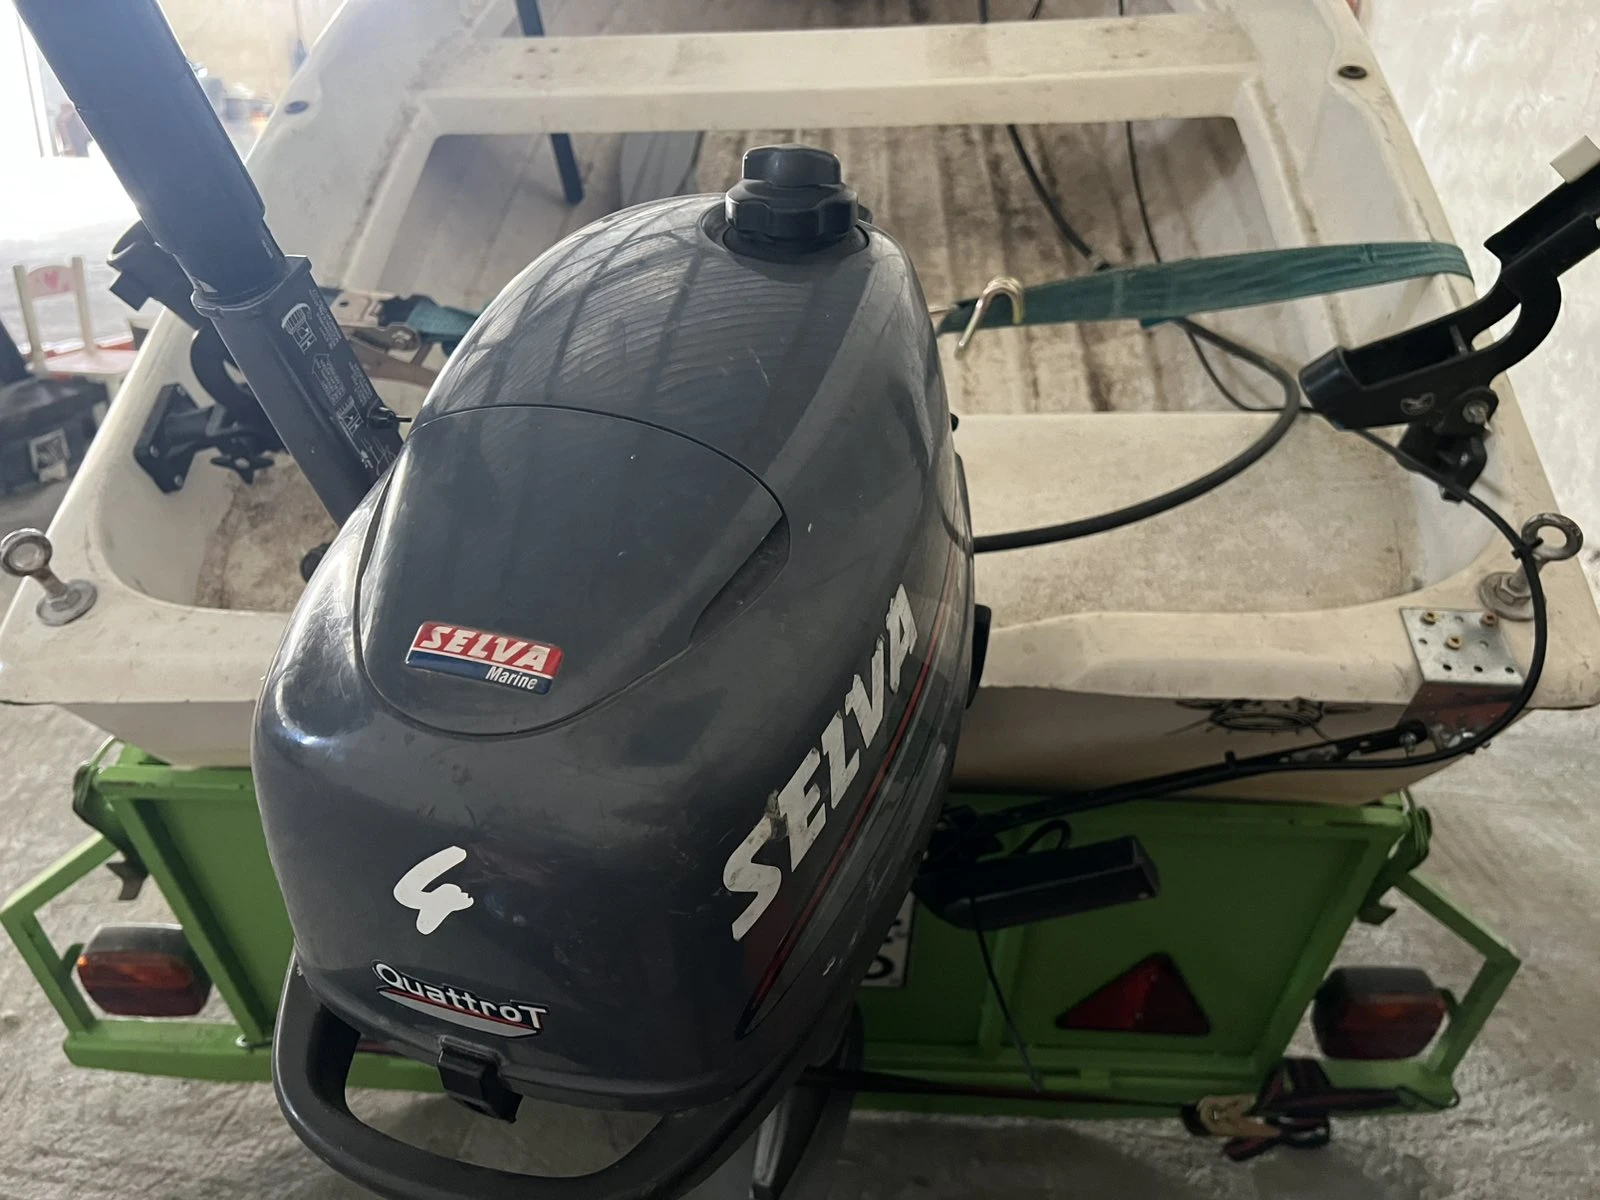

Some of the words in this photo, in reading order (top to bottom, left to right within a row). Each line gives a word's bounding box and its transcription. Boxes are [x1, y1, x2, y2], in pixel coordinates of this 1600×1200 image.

[420, 625, 551, 672] SELVA
[485, 667, 538, 690] Marine
[723, 584, 918, 941] SELVA
[393, 845, 474, 935] 4
[376, 962, 548, 1029] QuattroT
